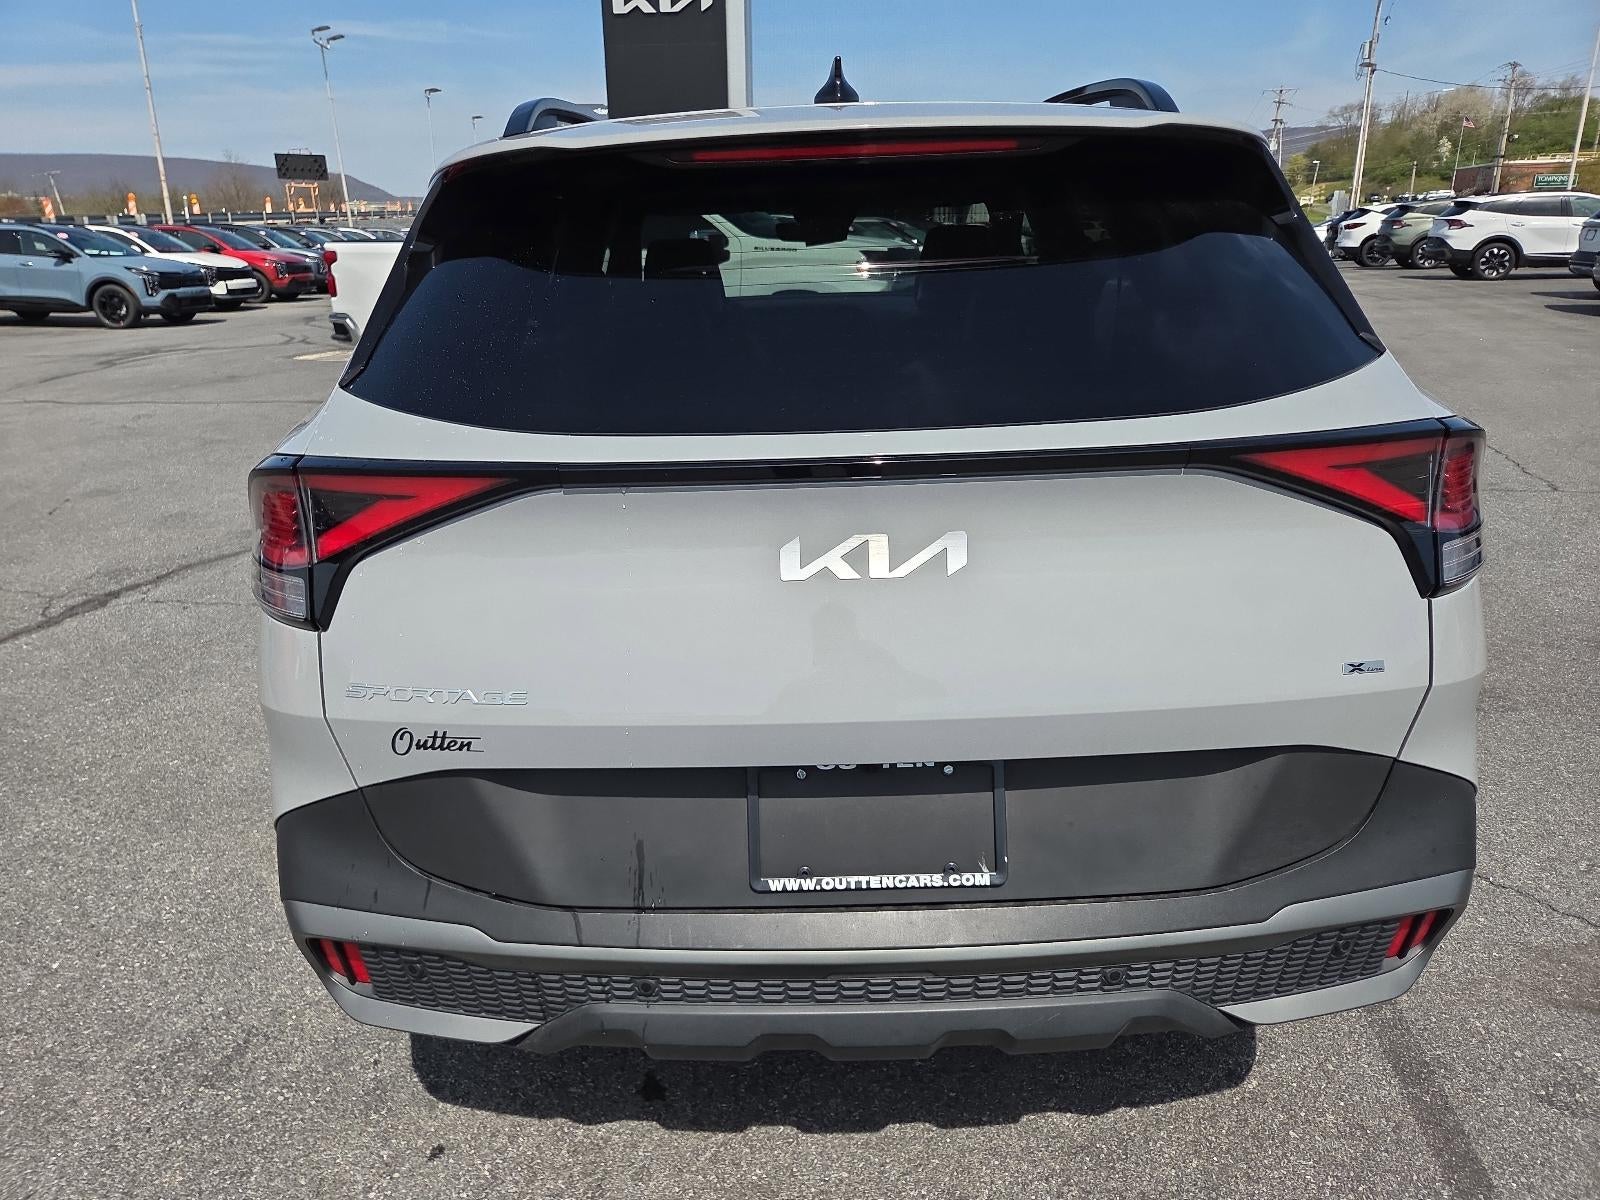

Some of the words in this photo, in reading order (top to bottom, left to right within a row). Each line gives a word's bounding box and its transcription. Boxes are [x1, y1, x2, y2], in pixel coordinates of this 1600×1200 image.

[779, 530, 968, 582] KIA
[345, 683, 529, 706] SPORTAGE
[391, 727, 485, 756] Outten
[768, 873, 991, 892] WWW.OUTTENCARS.COM
